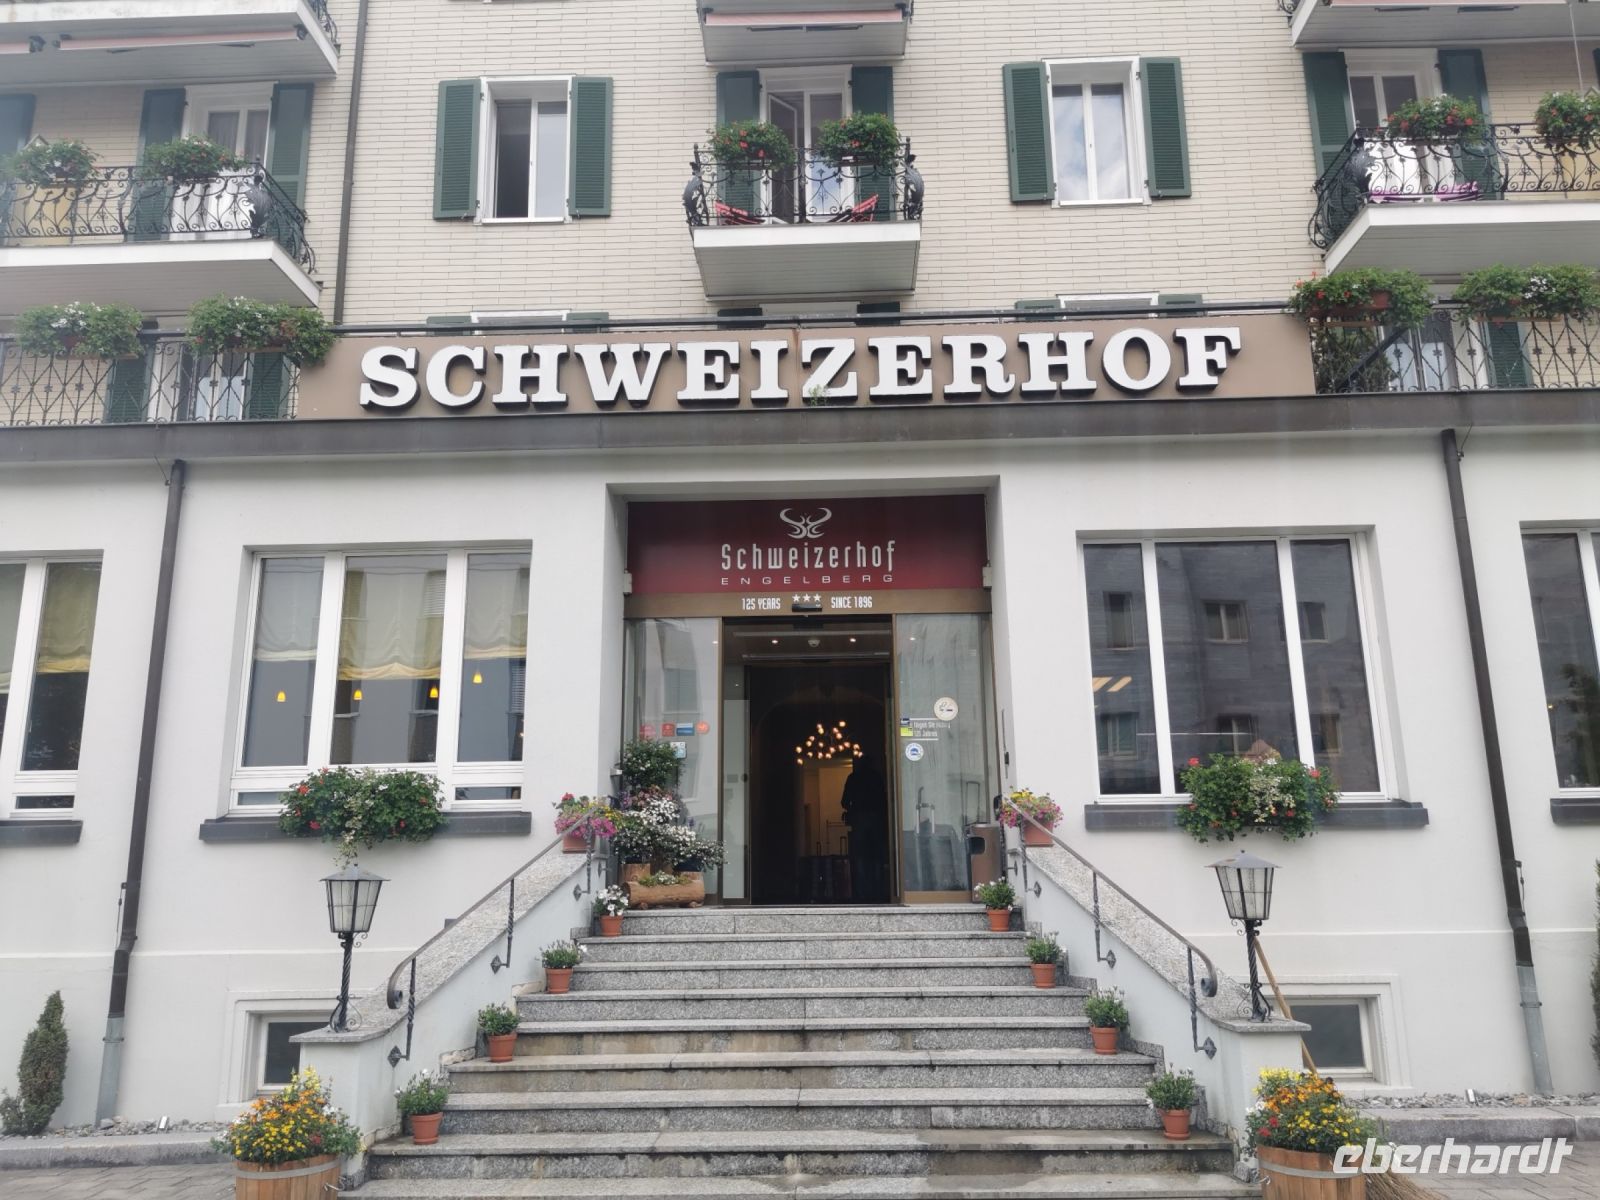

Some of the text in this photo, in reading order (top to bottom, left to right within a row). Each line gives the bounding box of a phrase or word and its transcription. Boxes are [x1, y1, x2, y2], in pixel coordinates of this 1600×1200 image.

[359, 326, 1242, 410] SCHWEIZERHOF
[721, 540, 896, 572] Schweizerhof
[721, 574, 893, 585] ENGELBERG
[741, 597, 781, 610] 125 YEARS
[831, 596, 873, 609] SINCE 1896
